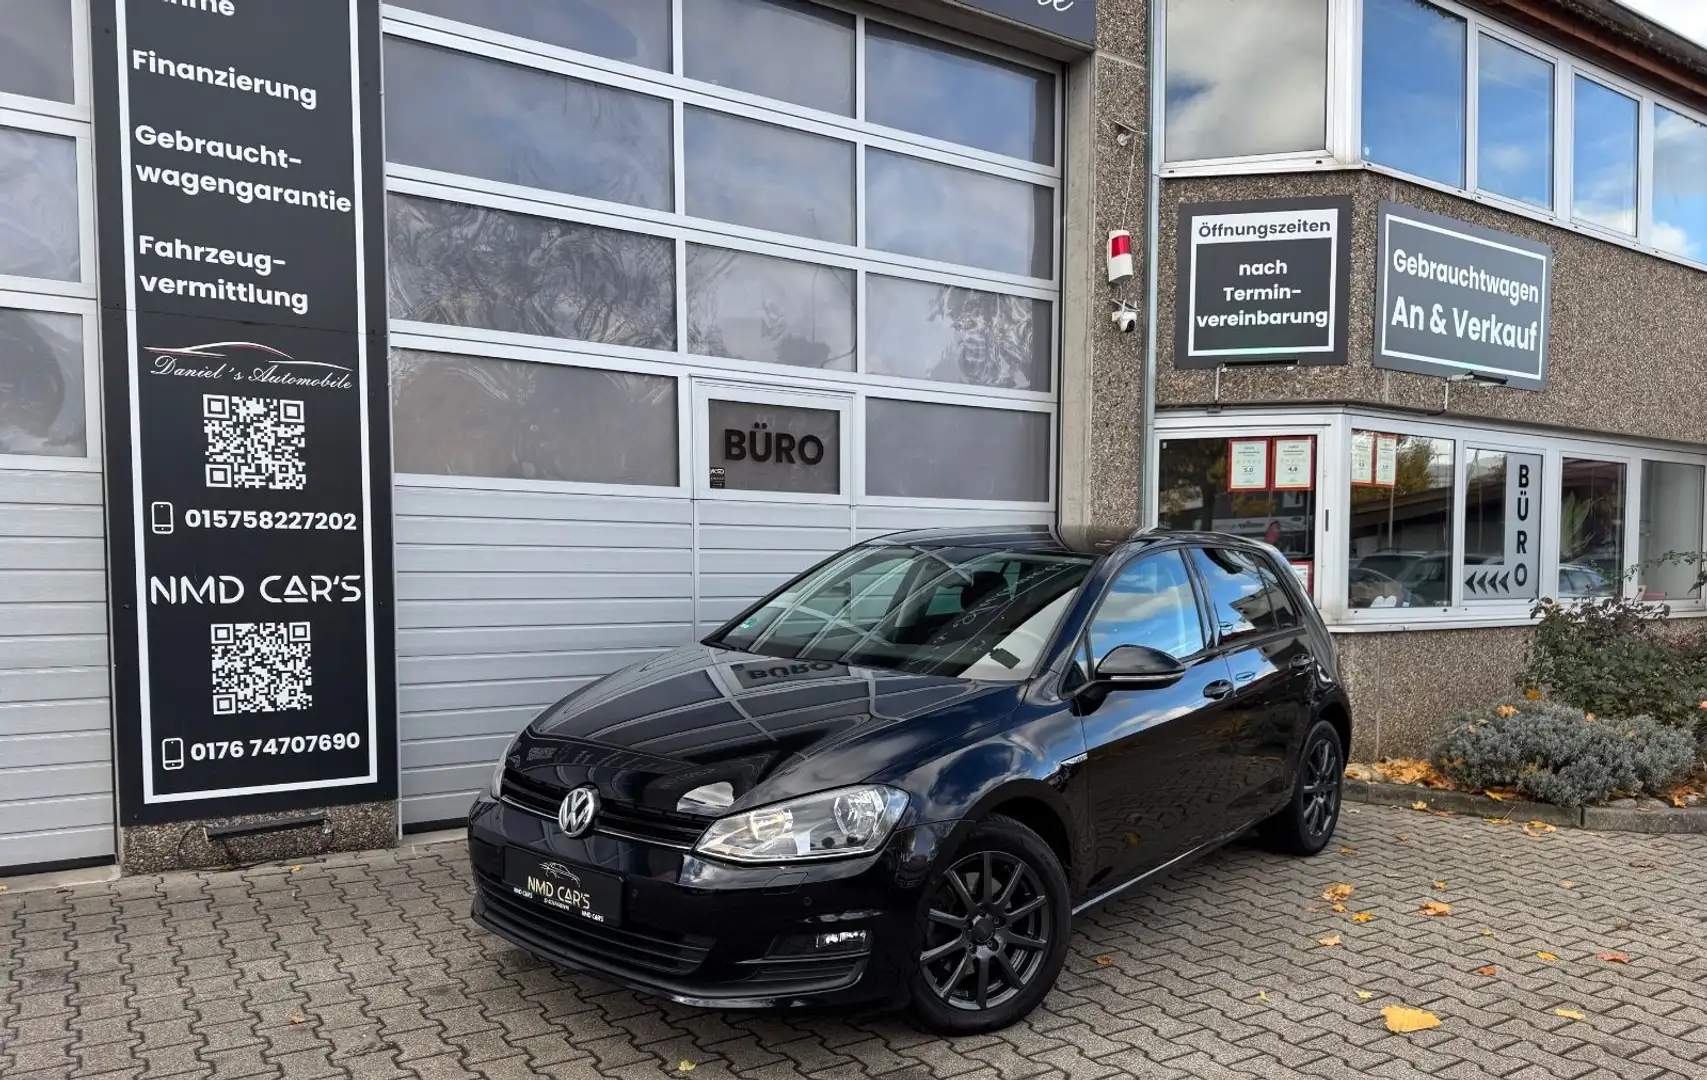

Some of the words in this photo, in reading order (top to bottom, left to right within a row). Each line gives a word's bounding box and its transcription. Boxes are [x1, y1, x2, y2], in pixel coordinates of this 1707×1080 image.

[132, 49, 317, 110] Finanzierung
[135, 124, 302, 169] Gebraucht-
[135, 164, 351, 212] wagengarantie
[1198, 219, 1331, 239] Öffnungszeiten
[139, 234, 286, 276] Fahrzeug-
[1238, 259, 1288, 276] nach
[139, 274, 308, 315] vermittlung
[1223, 283, 1302, 302] Termin-
[1393, 248, 1539, 307] Gebrauchtwagen
[1196, 310, 1328, 328] vereinbarung
[1391, 296, 1424, 331] An
[1430, 303, 1448, 336] &
[1452, 307, 1538, 351] Verkauf
[248, 364, 354, 389] Automobile
[724, 421, 824, 466] BÜRO
[185, 509, 357, 531] 015758227202
[1514, 464, 1529, 587] BÜRO
[150, 575, 245, 605] NMD
[259, 575, 362, 603] CAR'S
[190, 740, 244, 761] 0176
[250, 732, 361, 757] 74707690
[527, 875, 554, 897] NMD
[557, 886, 591, 910] CAR'S
